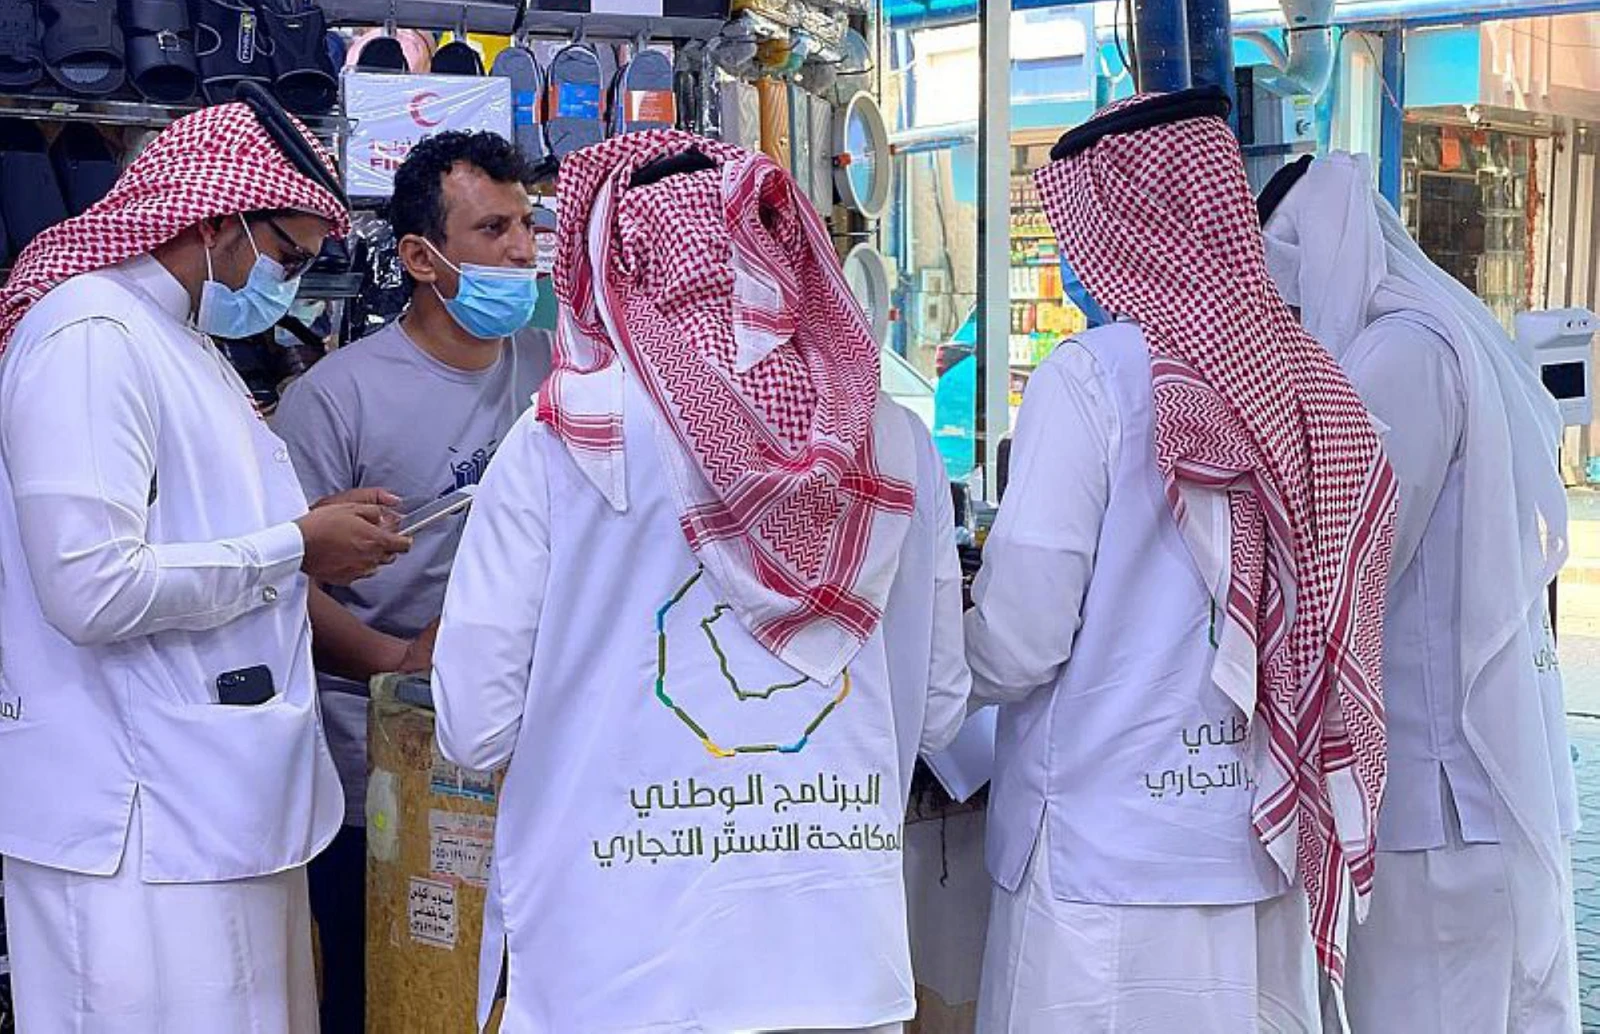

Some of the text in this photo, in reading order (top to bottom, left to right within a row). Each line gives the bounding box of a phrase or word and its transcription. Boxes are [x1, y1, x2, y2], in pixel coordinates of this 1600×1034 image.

[630, 773, 881, 818] البرنامج الوطني
[1145, 761, 1241, 798] التجاري
[593, 826, 703, 867] التجاري
